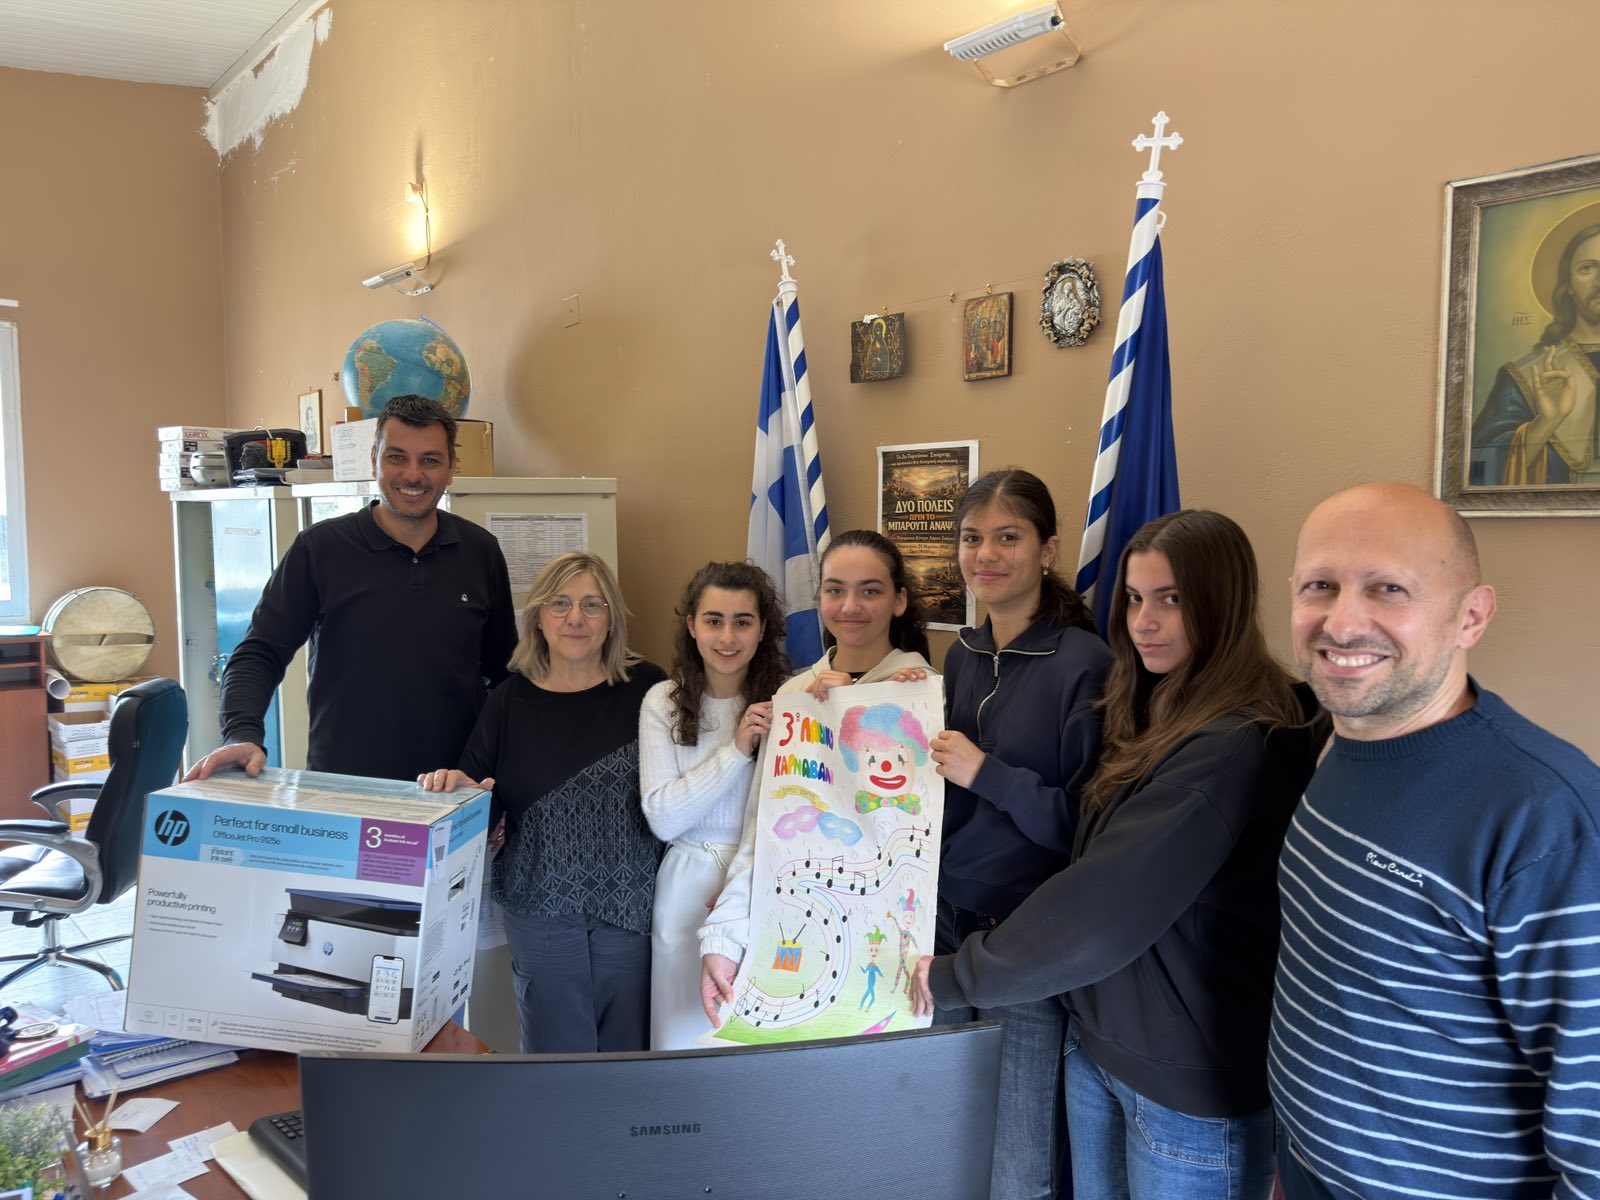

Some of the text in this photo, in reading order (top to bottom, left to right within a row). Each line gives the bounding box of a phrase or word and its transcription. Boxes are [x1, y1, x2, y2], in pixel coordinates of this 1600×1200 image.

[184, 431, 208, 439] XEROX
[895, 500, 915, 513] ΔΥΟ
[888, 521, 956, 530] ΜΠΑΡΟΥΤΙ ΑΝΑΨ
[156, 810, 190, 846] hp
[214, 815, 348, 840] Perfect for small business
[213, 830, 281, 845] OfficeJet Pro 9125e
[366, 826, 382, 848] 3
[148, 888, 188, 901] Powerfully
[147, 899, 217, 915] productive printing
[630, 1123, 702, 1137] SAMSUNG
